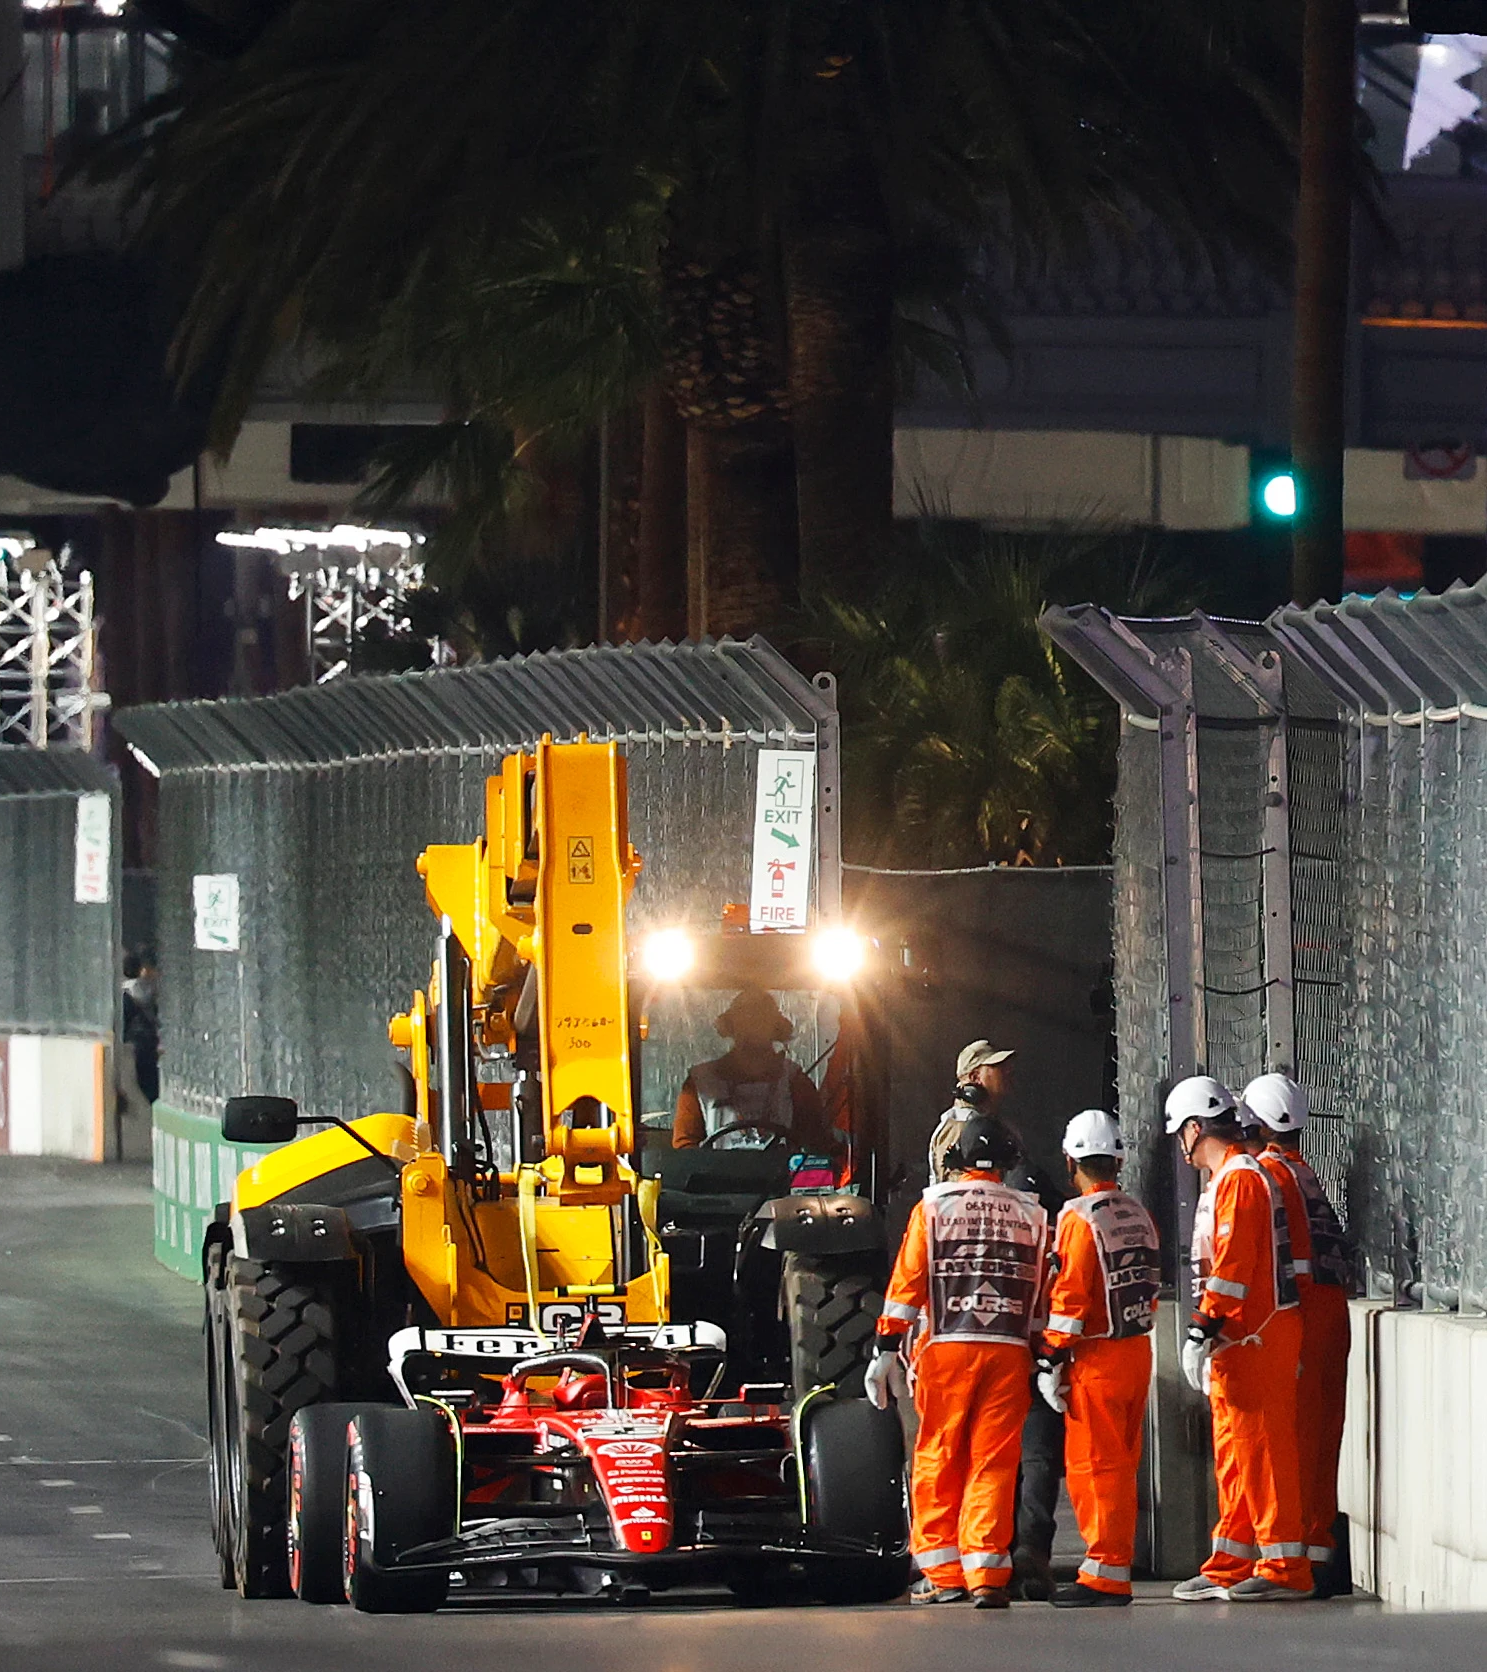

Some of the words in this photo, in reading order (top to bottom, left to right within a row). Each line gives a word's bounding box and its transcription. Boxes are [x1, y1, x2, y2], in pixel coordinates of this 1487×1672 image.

[764, 809, 802, 824] EXIT
[760, 906, 795, 921] FIRE
[203, 917, 232, 928] EXIT
[947, 1295, 1023, 1315] COURSE
[441, 1328, 678, 1355] Feri
